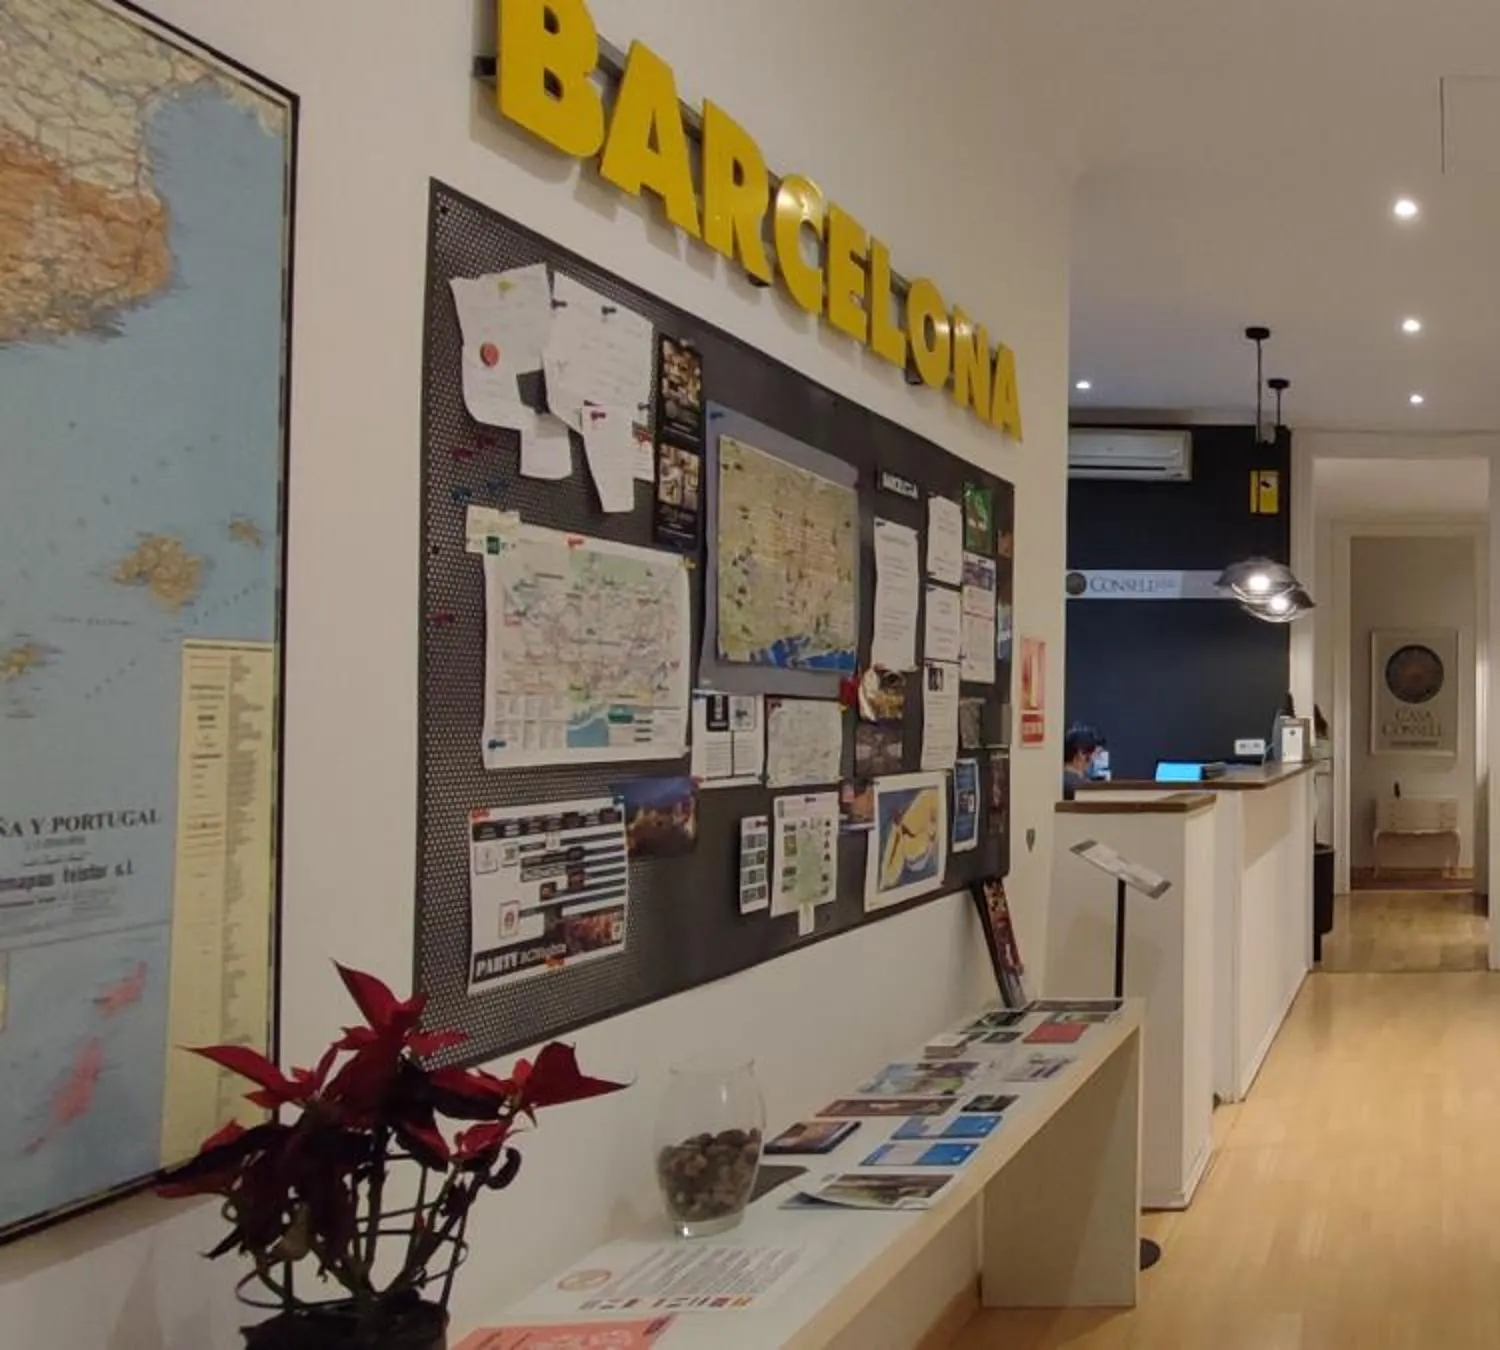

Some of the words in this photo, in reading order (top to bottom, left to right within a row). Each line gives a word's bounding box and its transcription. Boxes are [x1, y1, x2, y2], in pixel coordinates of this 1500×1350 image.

[498, 0, 1023, 443] BARCELONA
[31, 815, 46, 835] Y
[51, 807, 160, 834] PORTUGAL
